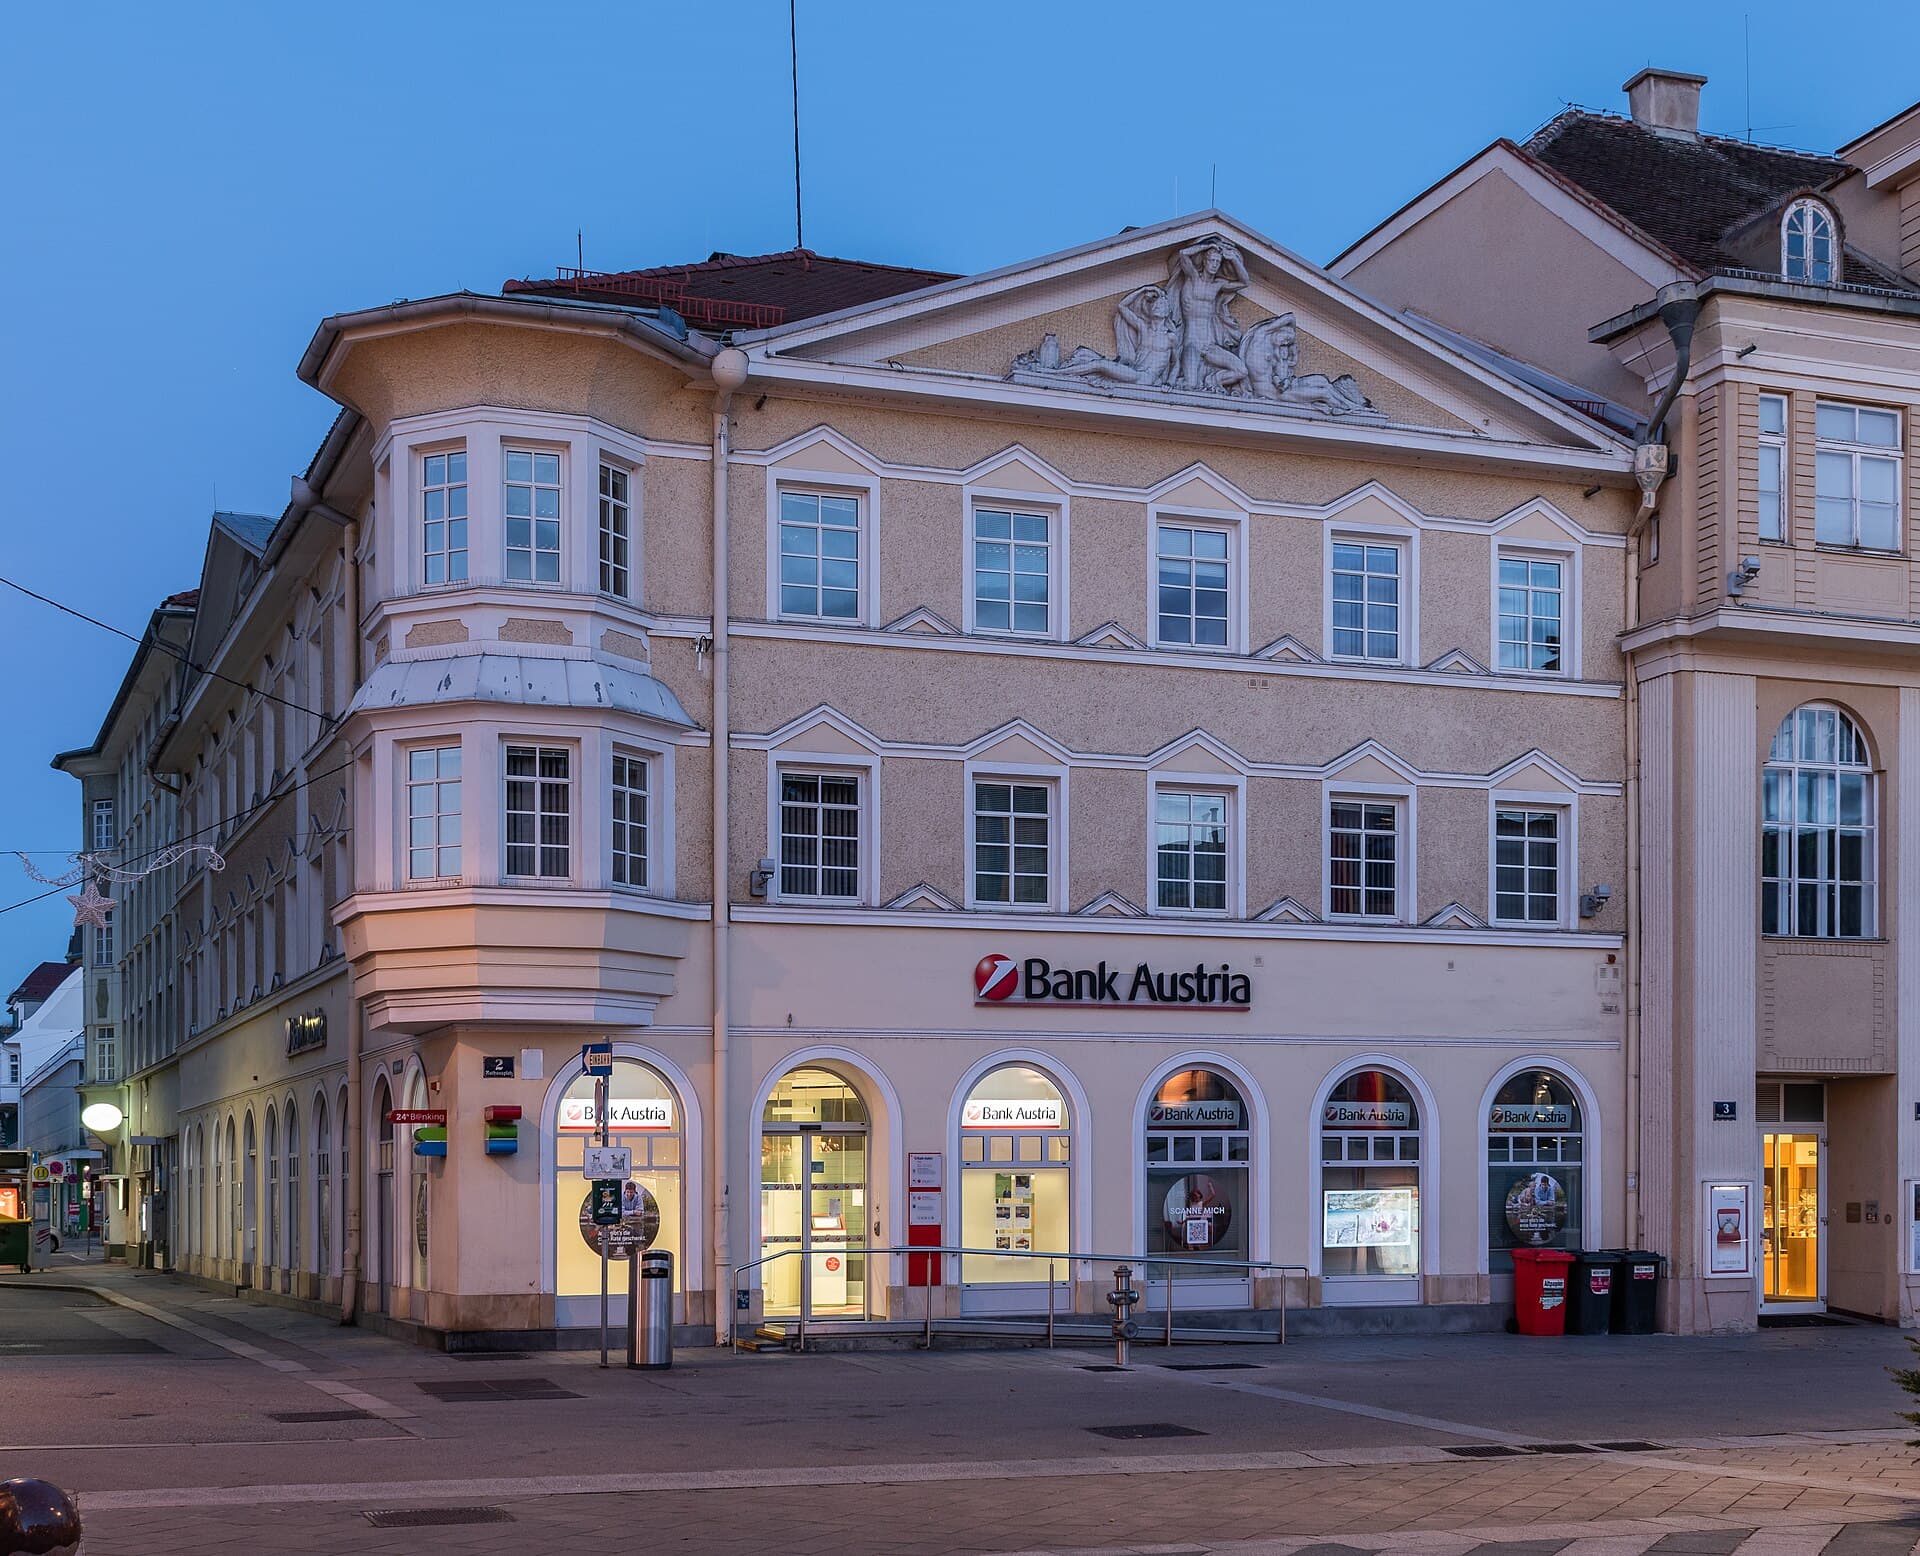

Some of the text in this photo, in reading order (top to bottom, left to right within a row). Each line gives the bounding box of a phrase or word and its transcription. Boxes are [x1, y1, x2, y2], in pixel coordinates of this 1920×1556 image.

[1024, 958, 1250, 1004] Bank Austria
[495, 1059, 503, 1070] 2
[584, 1106, 666, 1120] Bk Austria
[982, 1106, 1056, 1120] Bank Austria
[1165, 1107, 1234, 1120] Bank Austria
[1339, 1107, 1405, 1121] Bank Austria
[1723, 1103, 1729, 1114] 3
[1504, 1110, 1567, 1123] Bank Austria
[1170, 1207, 1225, 1215] SCANNE MICH
